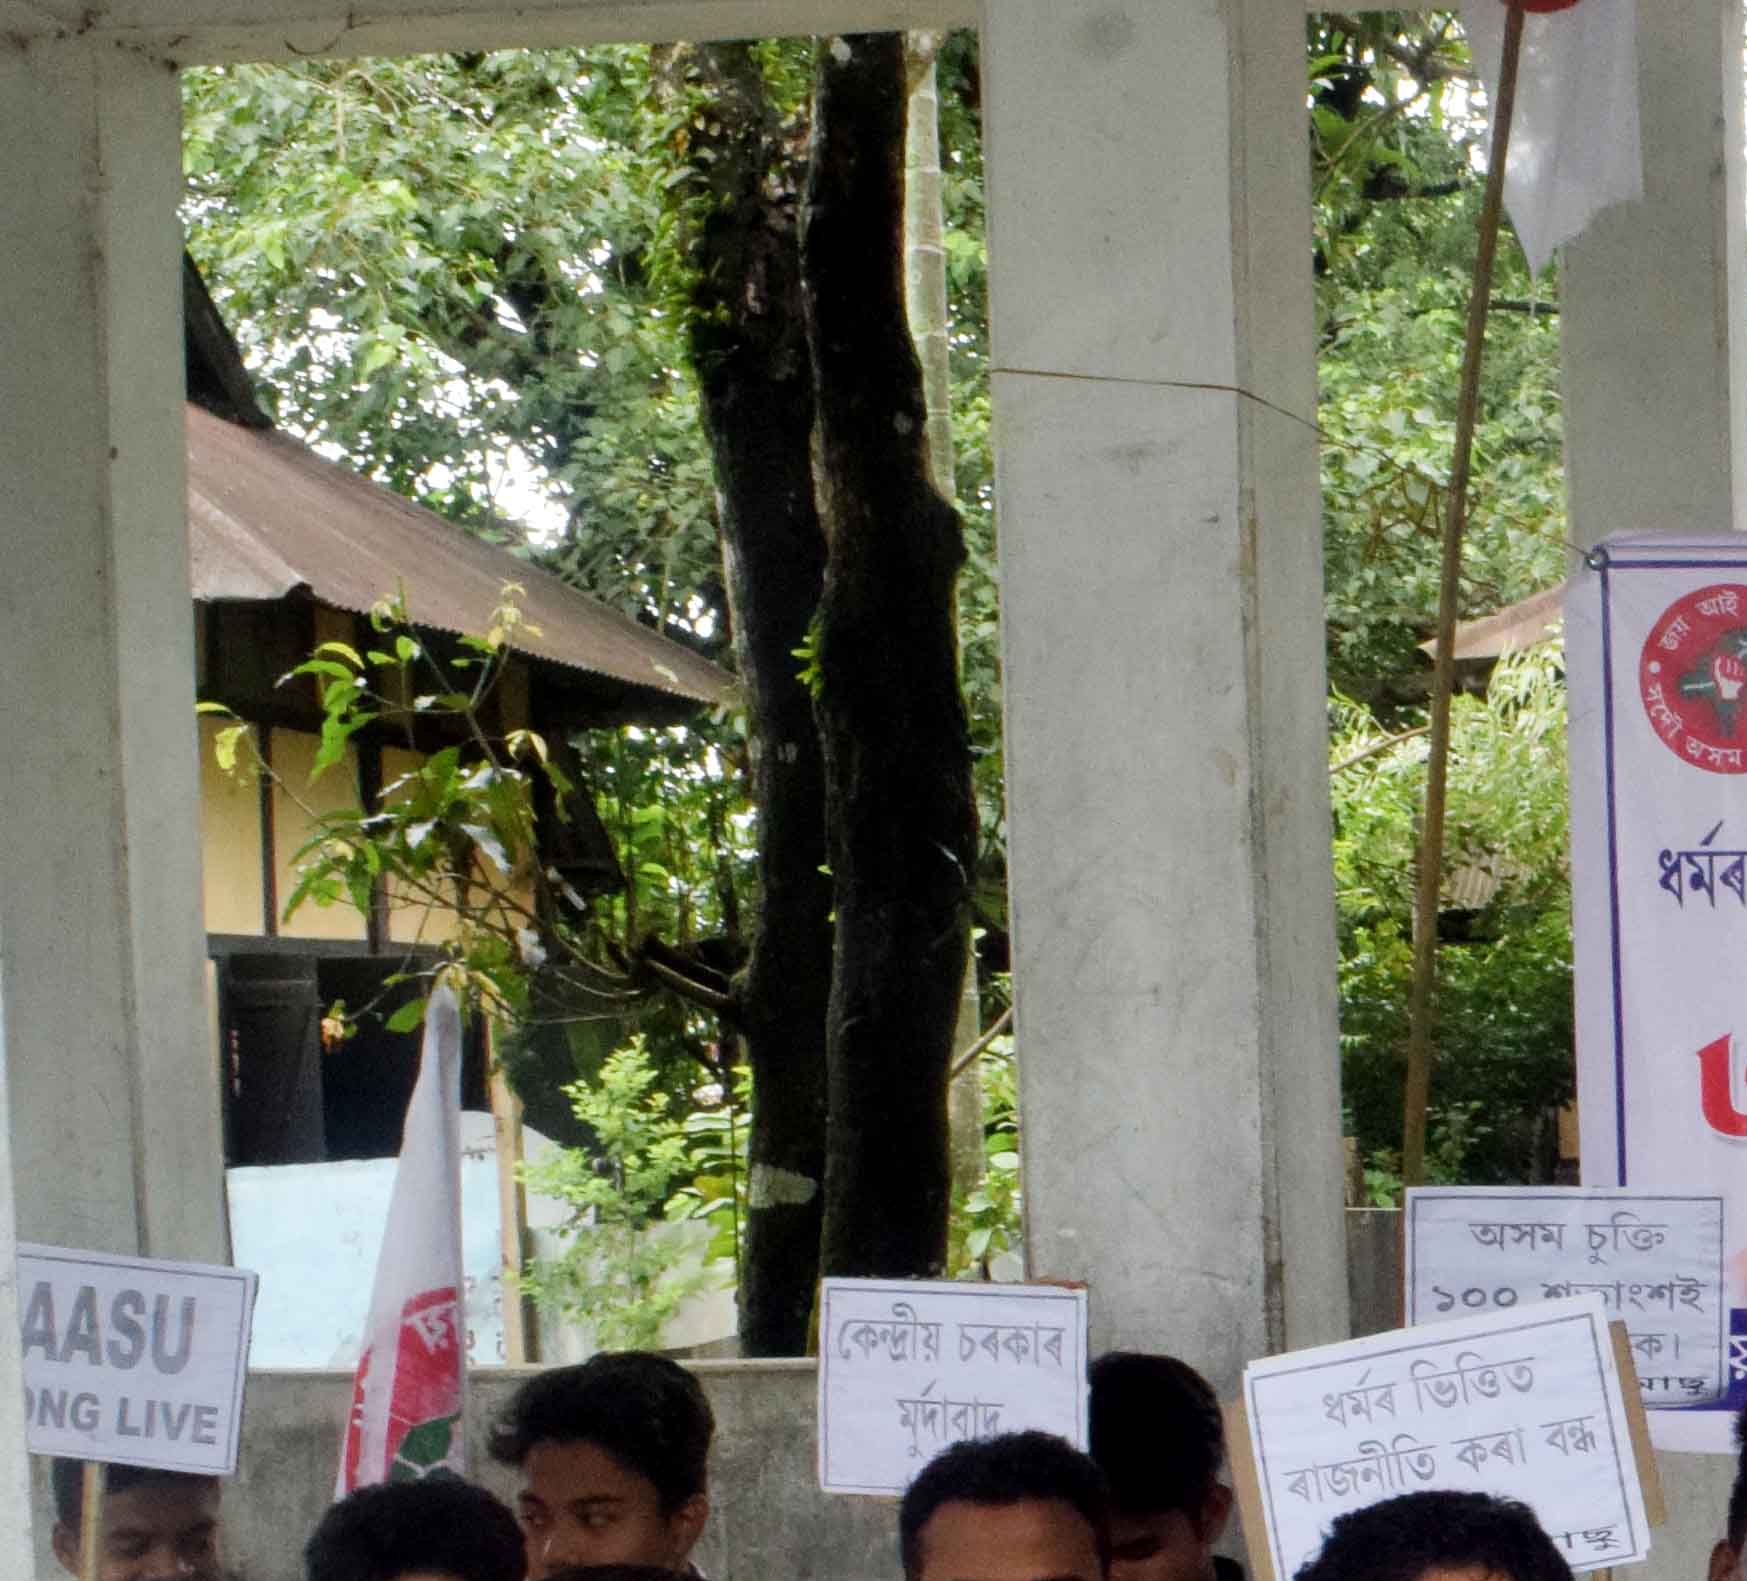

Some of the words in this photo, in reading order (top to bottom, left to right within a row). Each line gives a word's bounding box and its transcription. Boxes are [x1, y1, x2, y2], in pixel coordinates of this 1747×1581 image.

[1467, 1222, 1567, 1252] অসম
[1583, 1210, 1669, 1266] চুক্তি
[20, 1278, 200, 1377] AASU
[956, 1321, 1067, 1368] চৰকাৰ
[24, 1386, 101, 1432] NG
[114, 1394, 221, 1447] LIVE
[1320, 1369, 1397, 1428] ধৰ্মৰ
[1409, 1350, 1536, 1414] ভিত্তিত
[1449, 1427, 1527, 1473] কৰা
